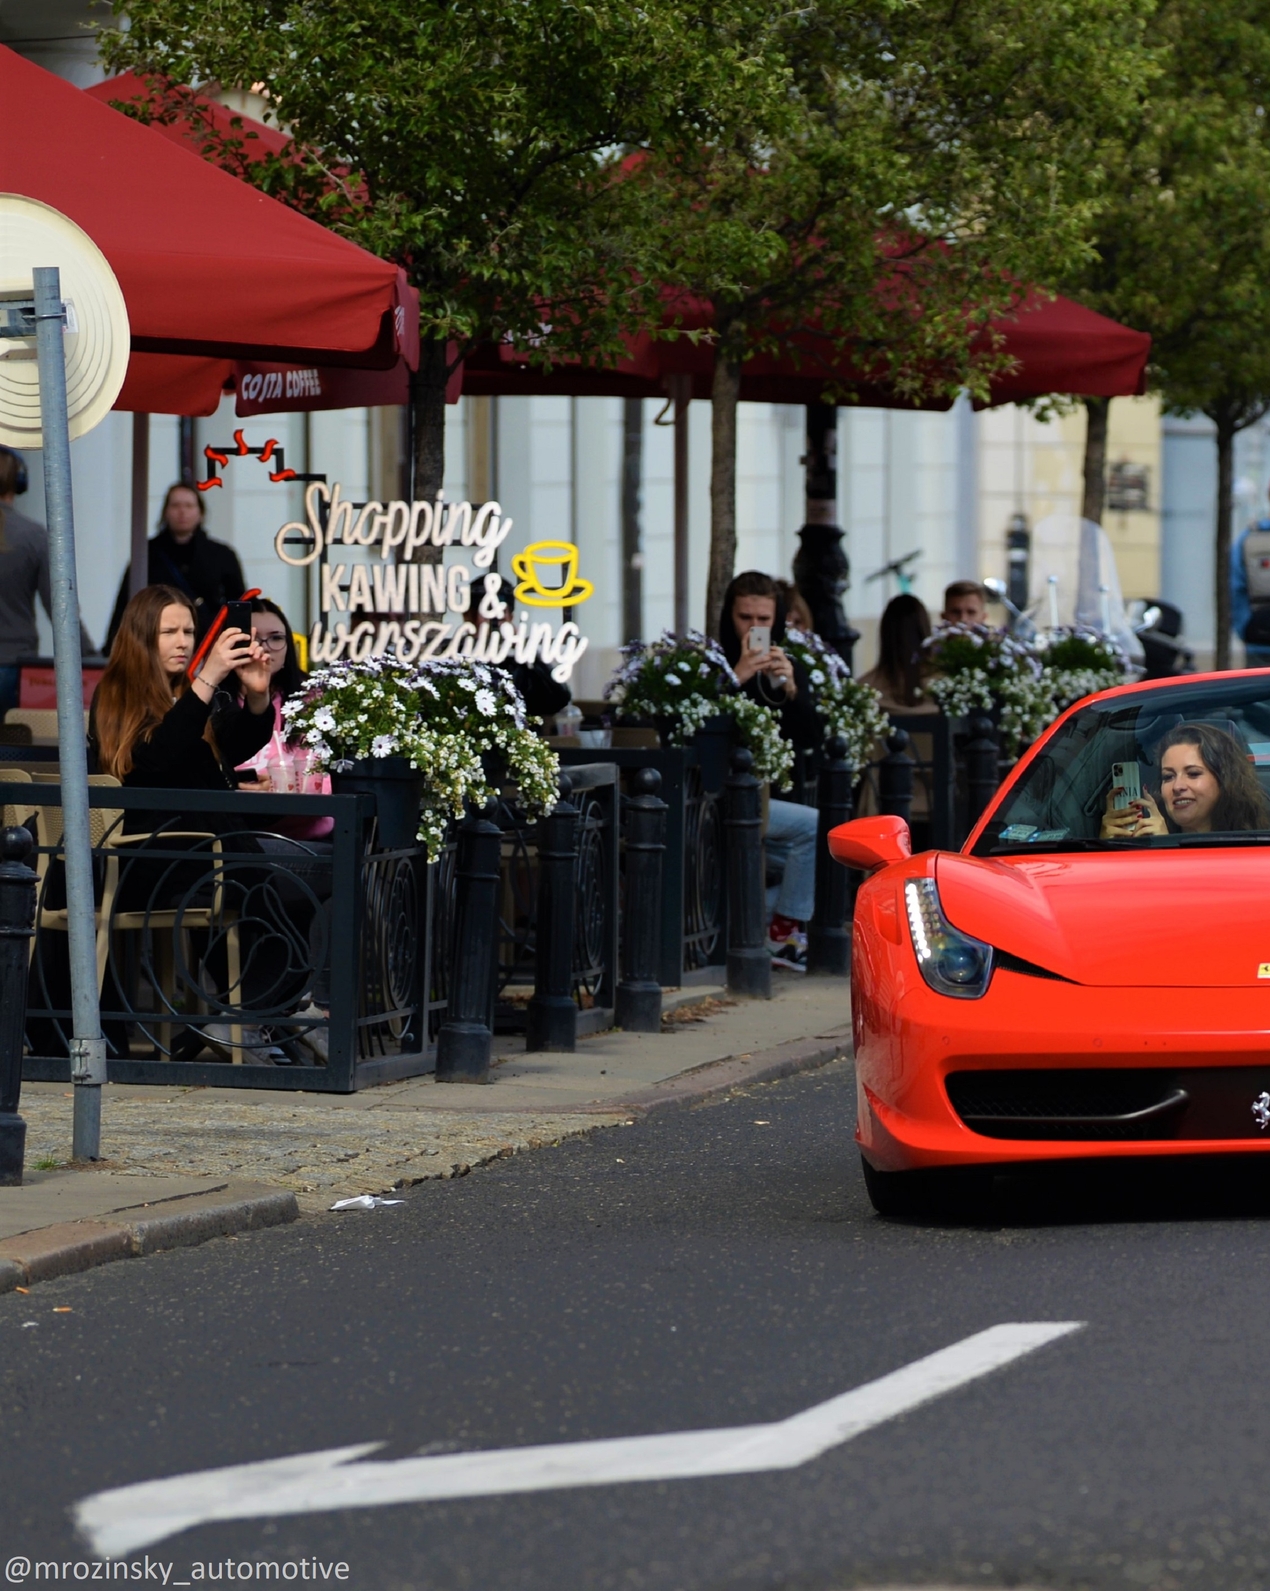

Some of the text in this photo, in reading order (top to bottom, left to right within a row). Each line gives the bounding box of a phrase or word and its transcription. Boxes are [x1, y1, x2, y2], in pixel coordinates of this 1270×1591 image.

[242, 369, 322, 402] COSTA COFFEE
[274, 481, 513, 567] Shopping
[322, 564, 507, 619] KAWING &
[310, 611, 588, 684] warszawing
